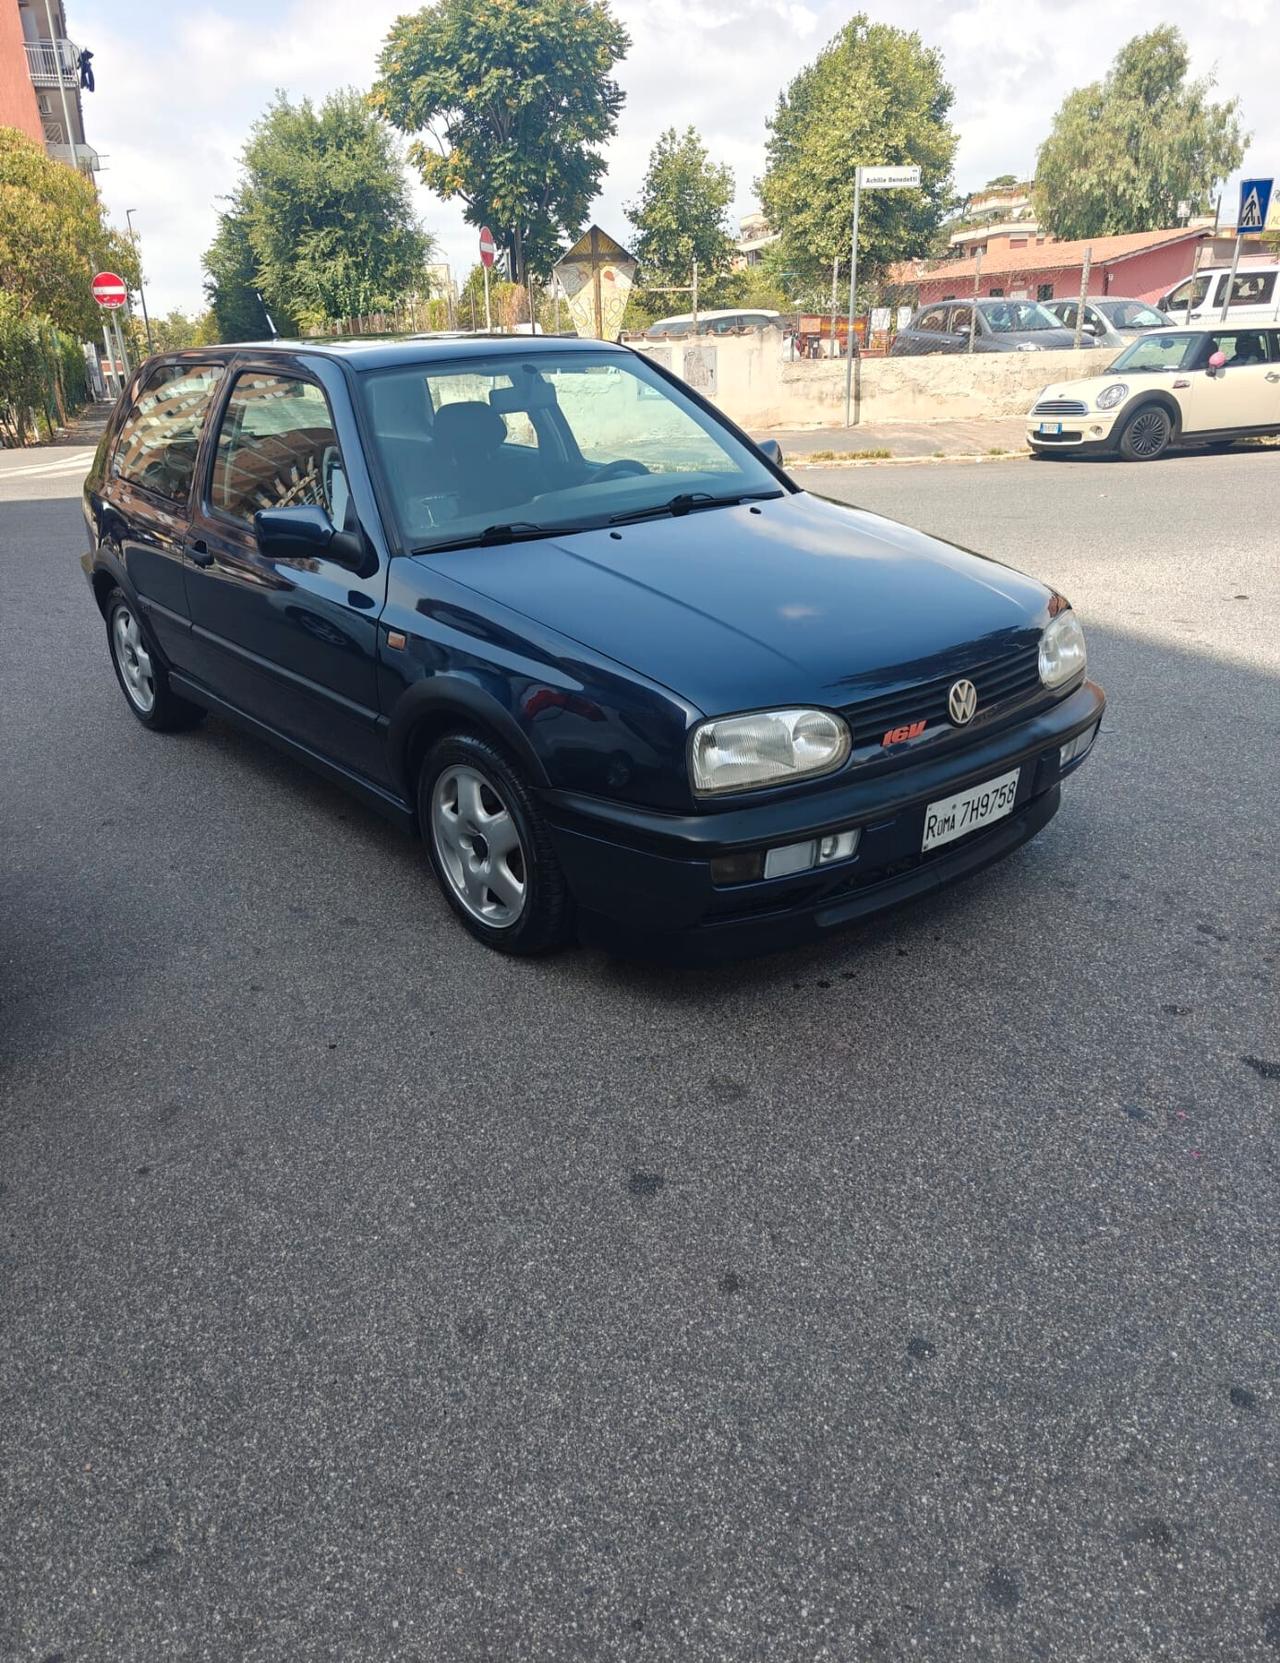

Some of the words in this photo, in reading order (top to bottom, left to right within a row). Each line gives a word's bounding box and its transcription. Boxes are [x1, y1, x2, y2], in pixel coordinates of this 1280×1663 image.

[949, 679, 977, 724] VW
[882, 720, 927, 746] 16V
[960, 780, 1016, 827] 7H9758
